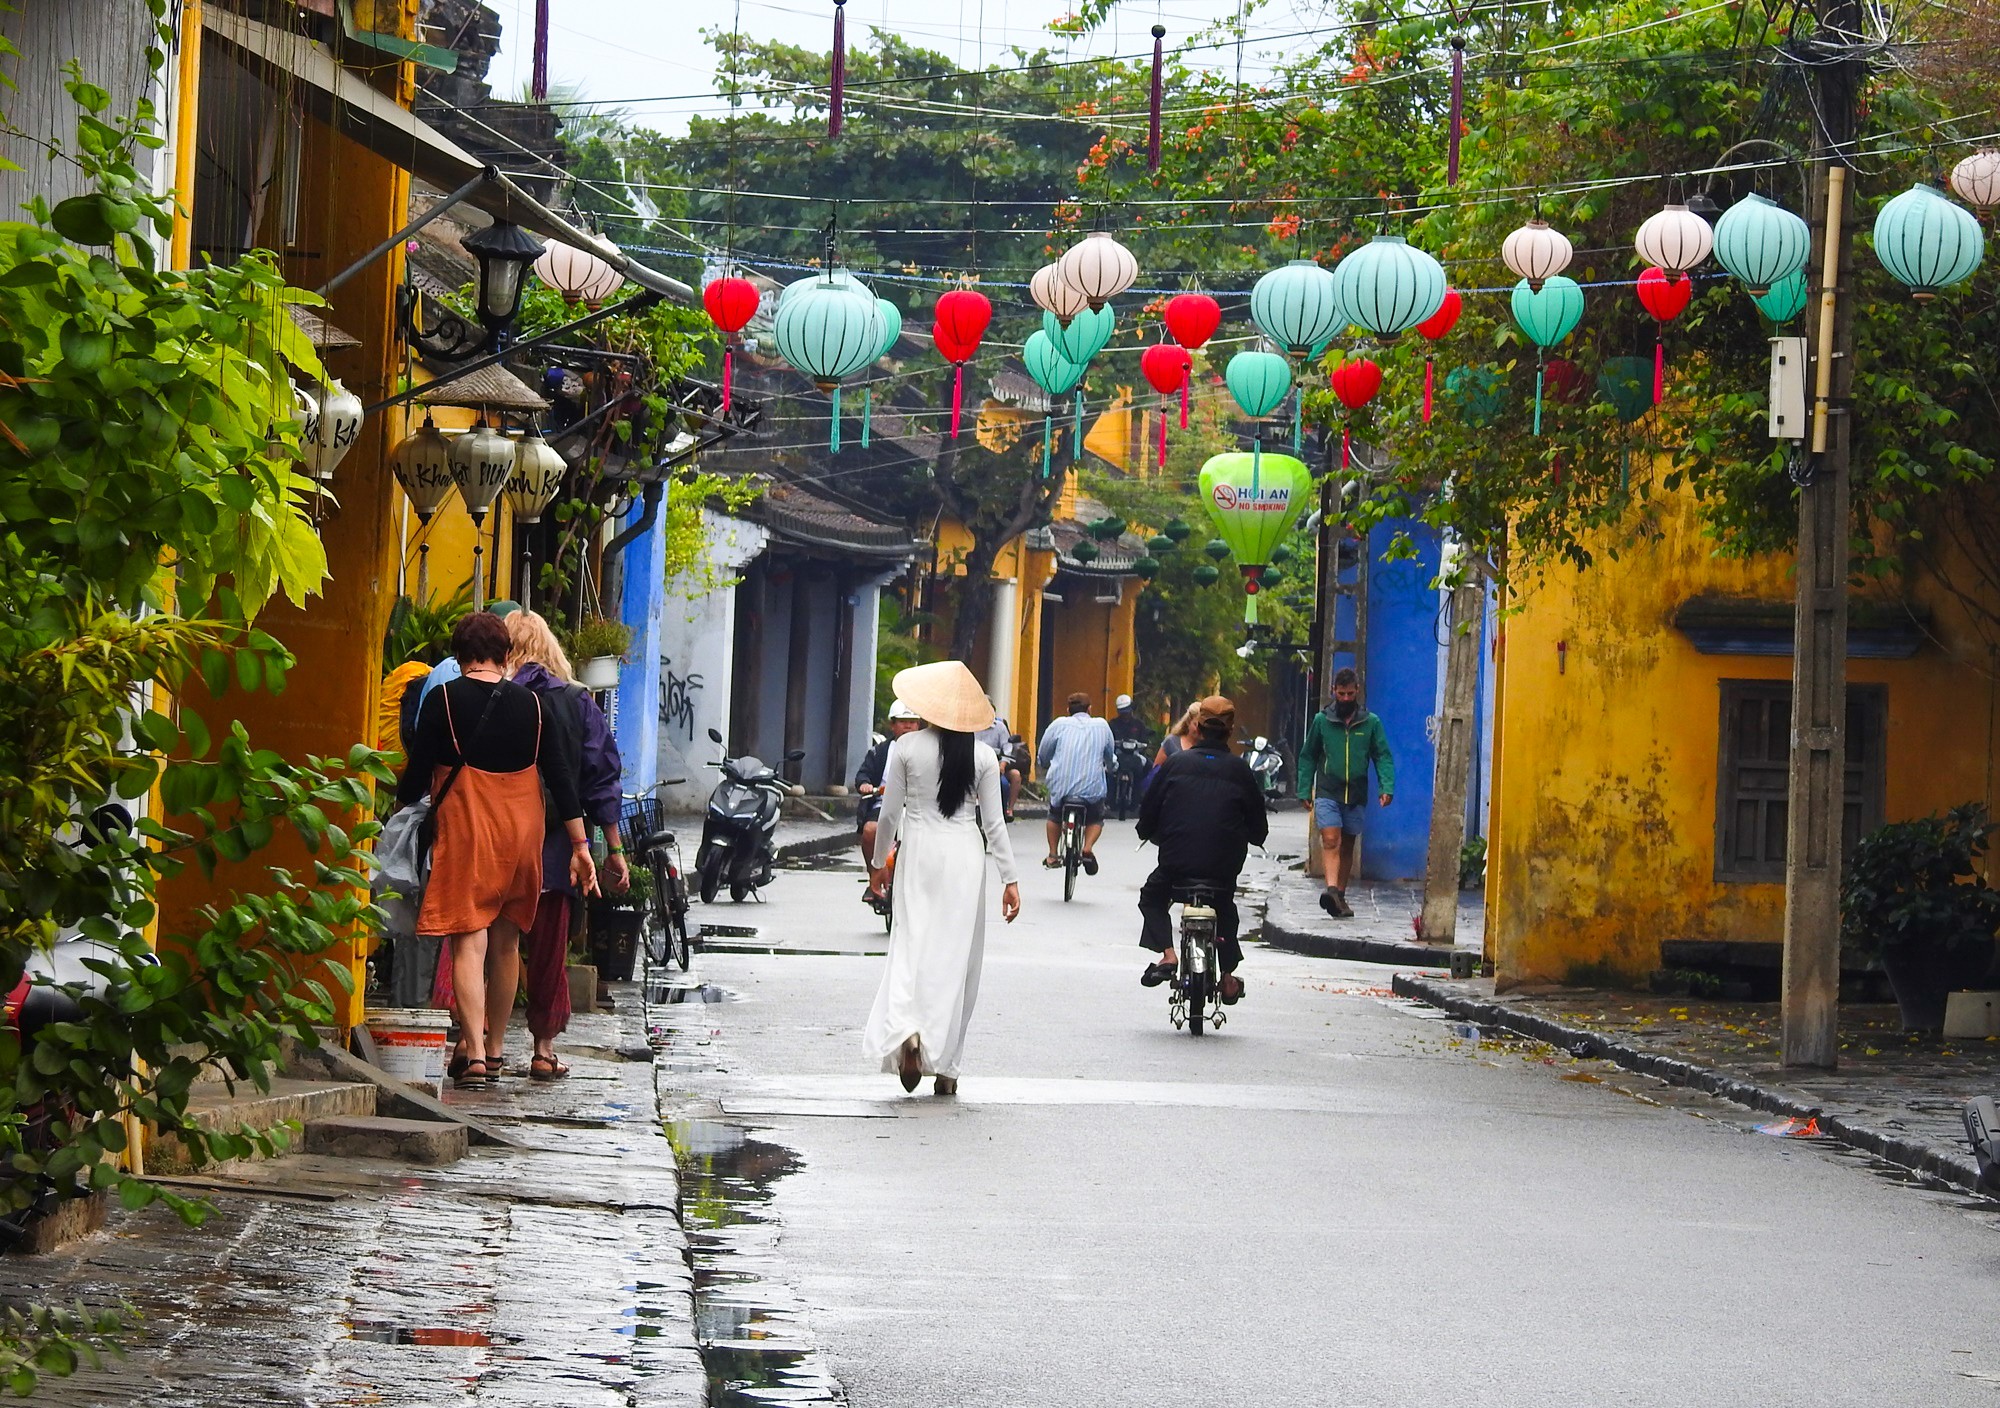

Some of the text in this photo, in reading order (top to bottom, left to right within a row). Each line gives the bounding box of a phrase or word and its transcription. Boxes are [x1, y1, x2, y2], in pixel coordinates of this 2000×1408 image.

[1269, 489, 1288, 499] AN
[1239, 502, 1286, 511] NO SMOKING
